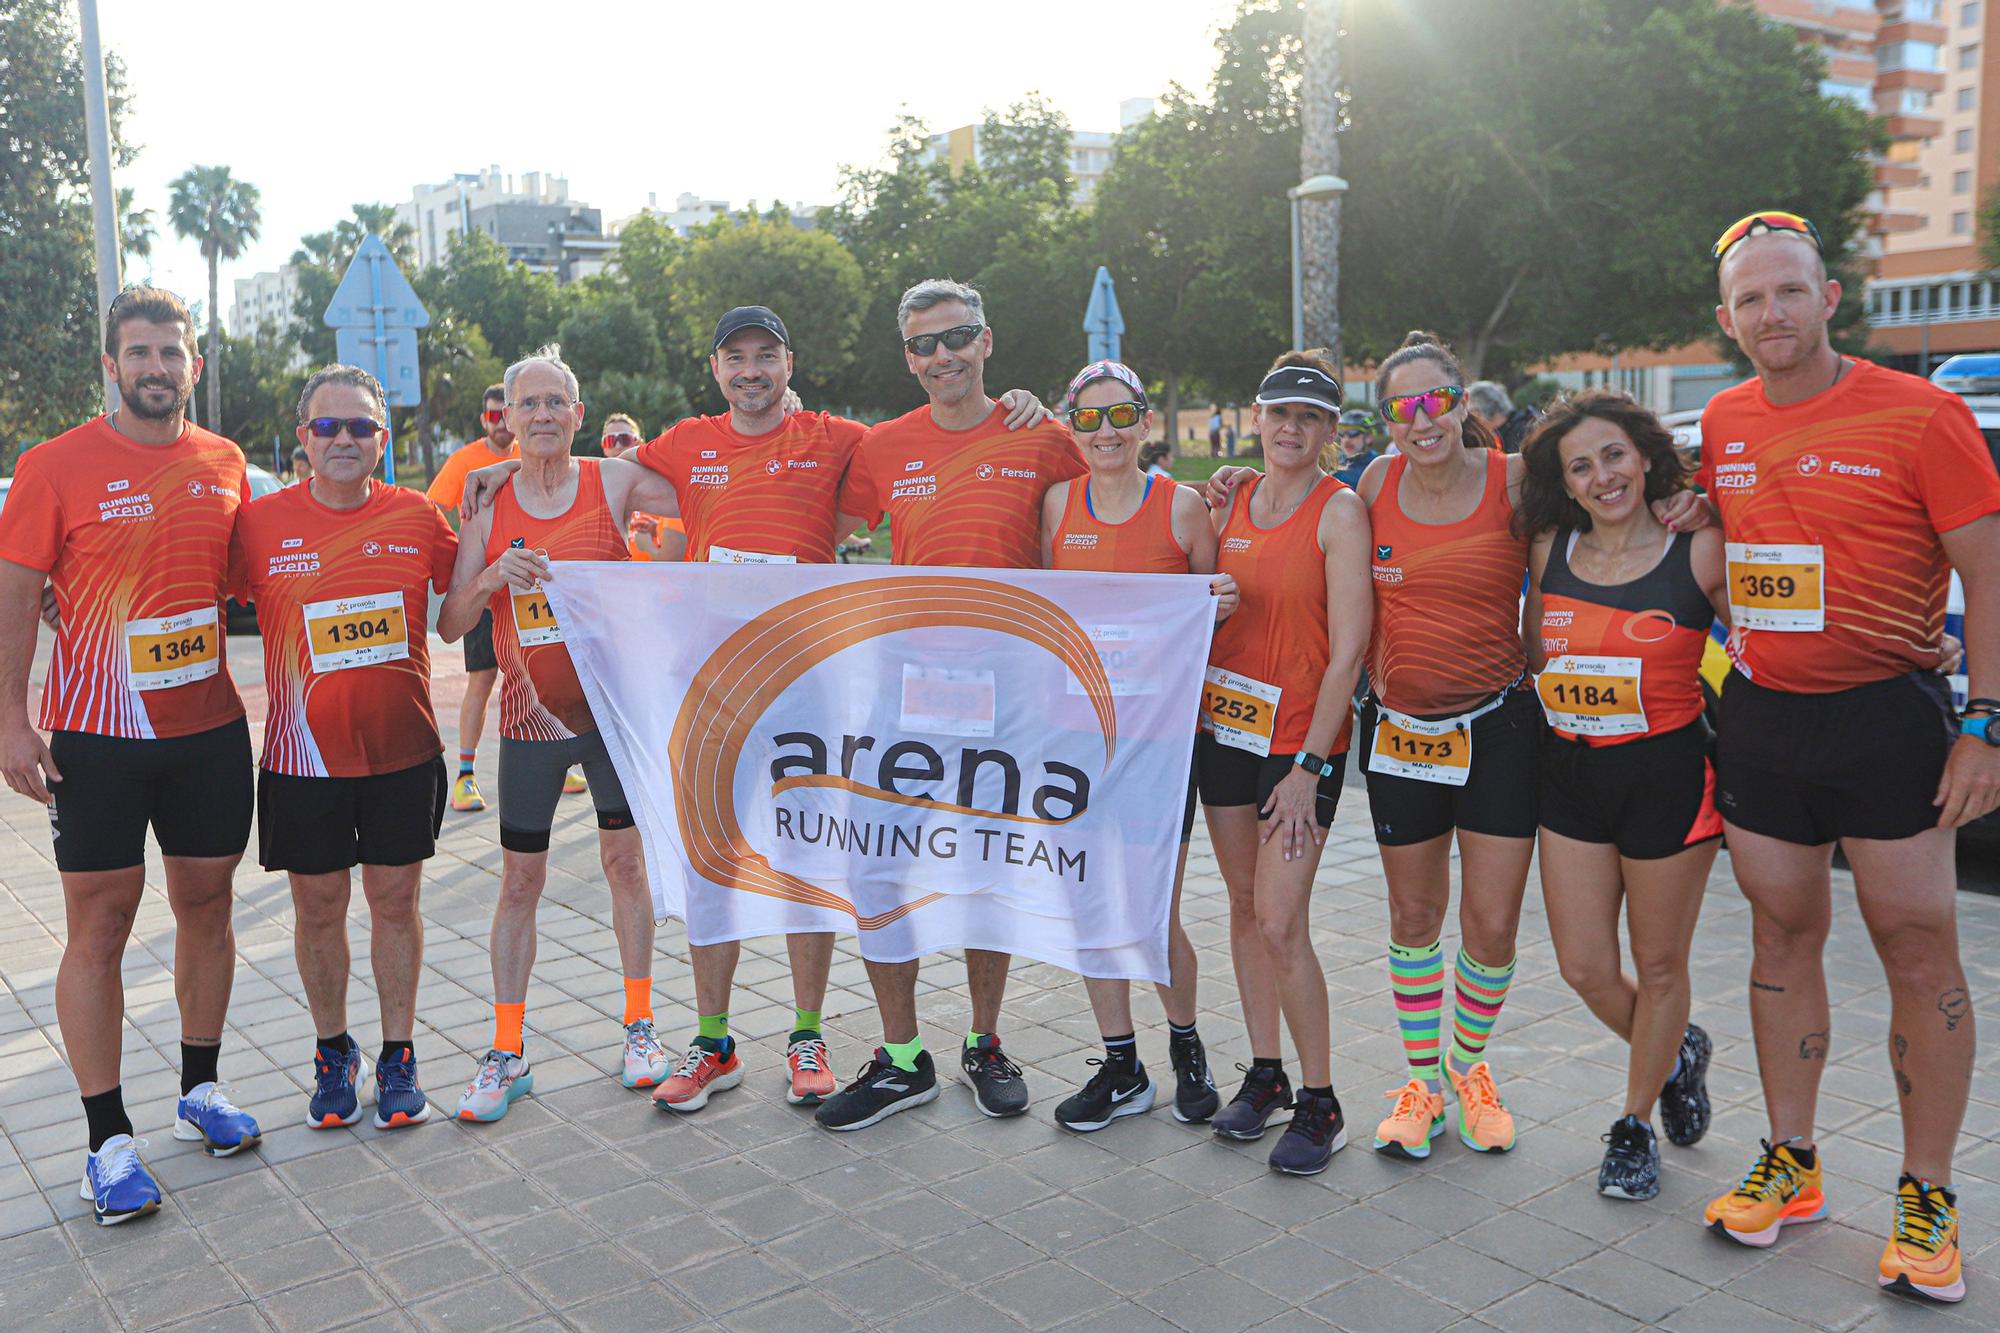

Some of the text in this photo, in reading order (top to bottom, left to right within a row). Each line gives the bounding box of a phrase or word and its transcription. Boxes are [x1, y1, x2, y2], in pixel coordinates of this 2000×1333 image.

[691, 465, 729, 474] RUNNING
[787, 459, 817, 469] Fersán
[1829, 460, 1881, 477] Fersán
[690, 474, 729, 485] arena
[1001, 467, 1036, 479] Fersán
[893, 475, 936, 488] RUNNING
[892, 484, 937, 500] arena
[99, 494, 150, 511] RUNNING
[101, 503, 154, 522] arena
[388, 544, 419, 556] Fersán
[269, 552, 319, 565] RUNNING
[268, 561, 321, 577] arena
[328, 618, 389, 644] 1304
[149, 634, 206, 662] 1364
[1577, 664, 1606, 673] prosolia
[1554, 683, 1618, 706] 1184
[1391, 735, 1453, 758] 1173
[770, 731, 1091, 822] arena
[775, 807, 1087, 882] RUNNING TEAM
